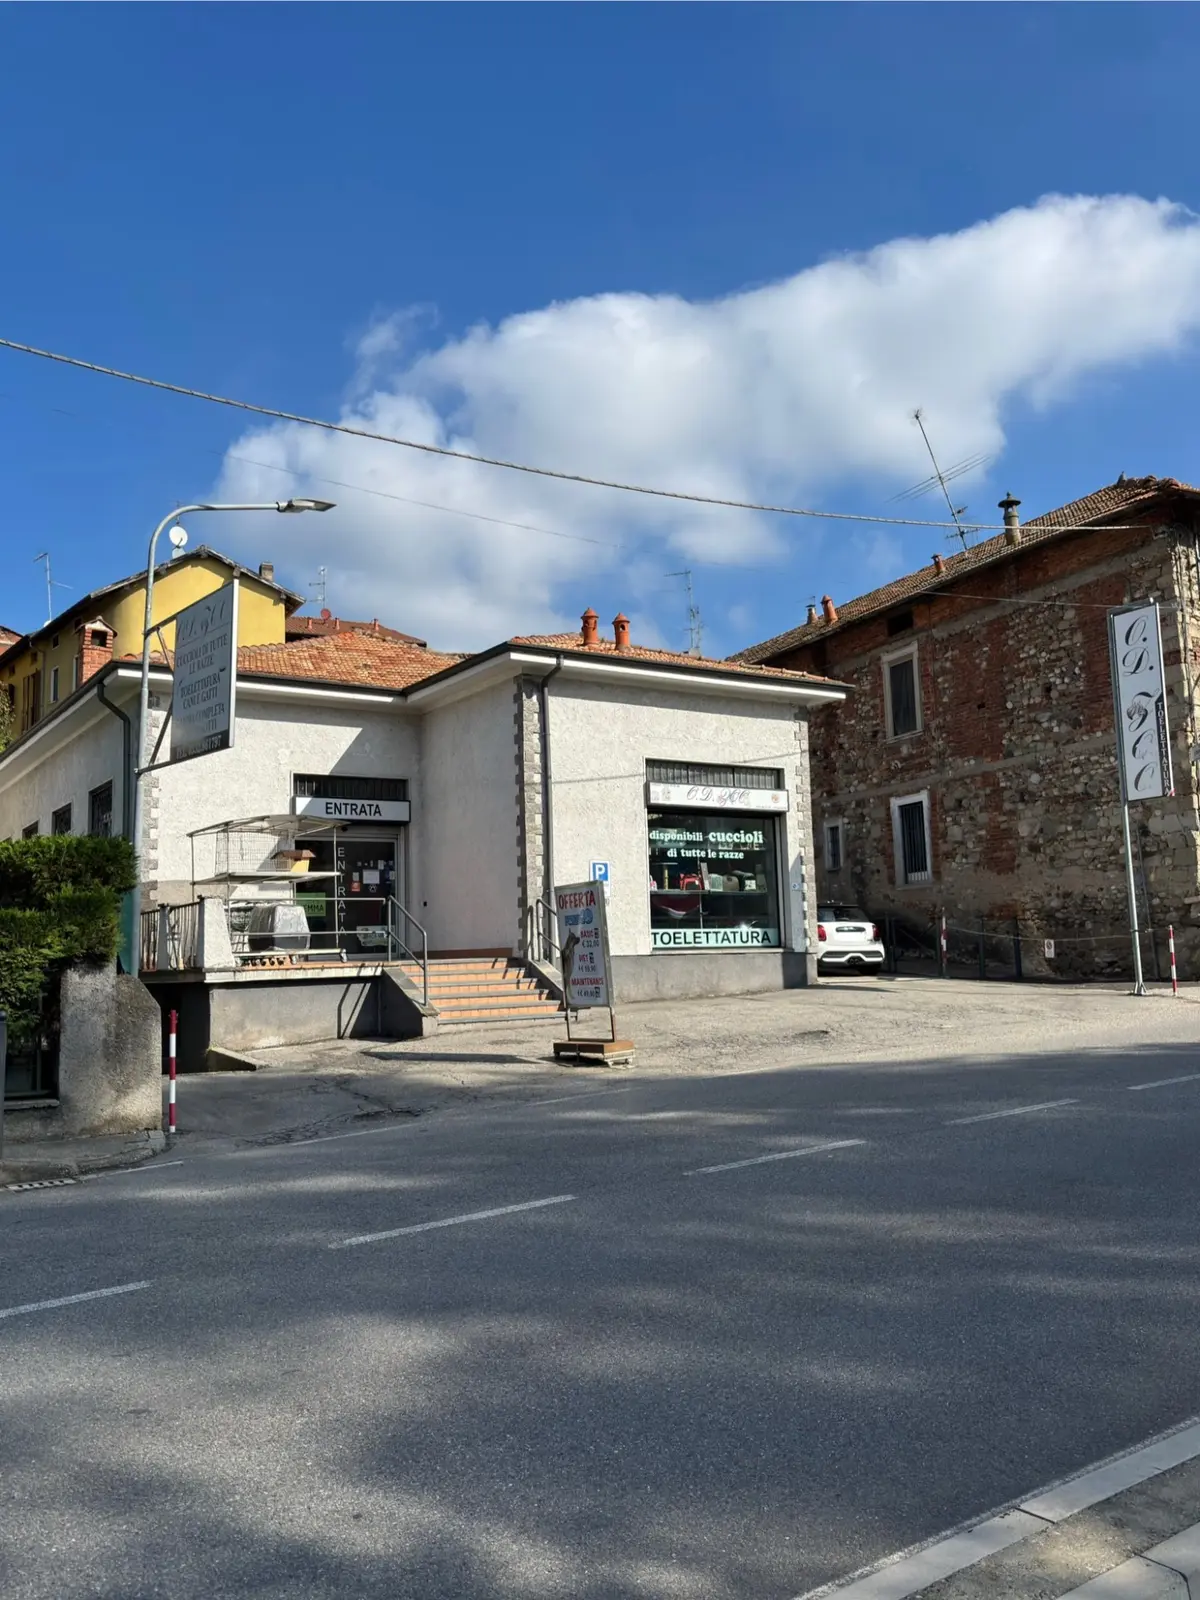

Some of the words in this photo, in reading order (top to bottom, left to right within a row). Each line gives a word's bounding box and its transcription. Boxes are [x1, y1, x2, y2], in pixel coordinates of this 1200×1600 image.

[325, 802, 382, 816] ENTRATA
[649, 830, 703, 841] disponibili
[708, 830, 763, 843] cuccioli
[667, 849, 677, 858] di
[681, 849, 706, 858] tutte
[707, 849, 716, 858] le
[719, 851, 744, 860] razze
[558, 890, 596, 909] OFFERTA
[650, 931, 772, 945] TOELETTATURA
